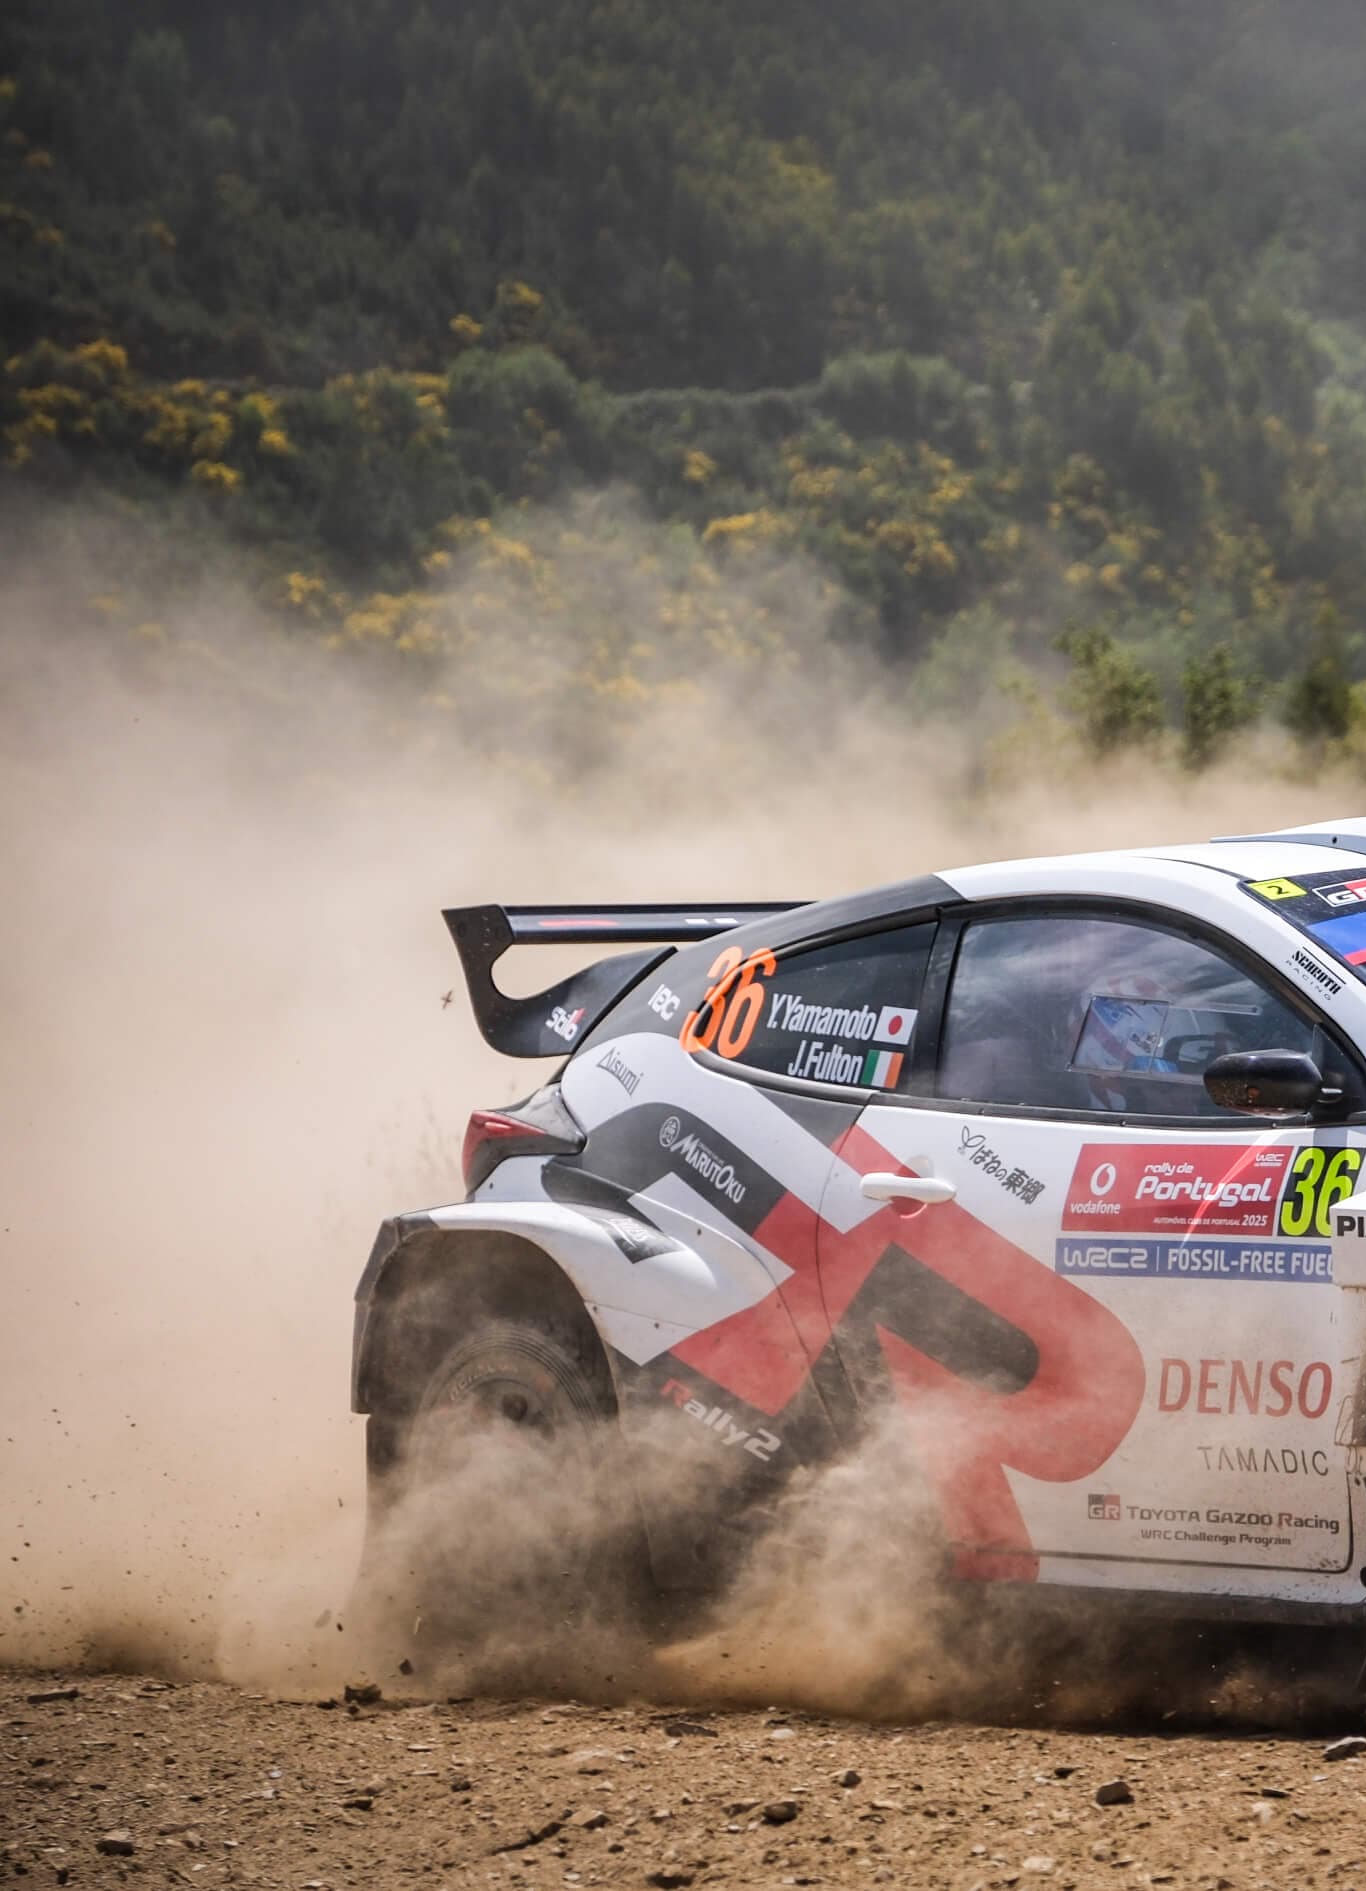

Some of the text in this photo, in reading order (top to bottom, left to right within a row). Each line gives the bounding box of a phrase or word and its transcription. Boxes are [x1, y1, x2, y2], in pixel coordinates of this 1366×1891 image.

[1266, 884, 1289, 896] 2
[1285, 959, 1332, 1001] RACING
[1291, 949, 1342, 996] SCHROTH
[679, 946, 777, 1058] 36
[1143, 1161, 1195, 1176] rally de
[1070, 1199, 1121, 1215] vodafone
[1135, 1175, 1273, 1208] Portugal
[1280, 1147, 1361, 1237] 36
[1241, 1214, 1269, 1227] 2025
[1167, 1248, 1285, 1275] FOSSIL-FREE
[1157, 1358, 1333, 1420] DENSO
[660, 1377, 782, 1462] Rally2
[1197, 1445, 1329, 1476] TAMADIC
[1126, 1505, 1201, 1522] TOYOTA
[1205, 1509, 1273, 1527] GAZOO
[1277, 1512, 1340, 1535] Racing
[1140, 1528, 1292, 1548] WRC Challenge Program
